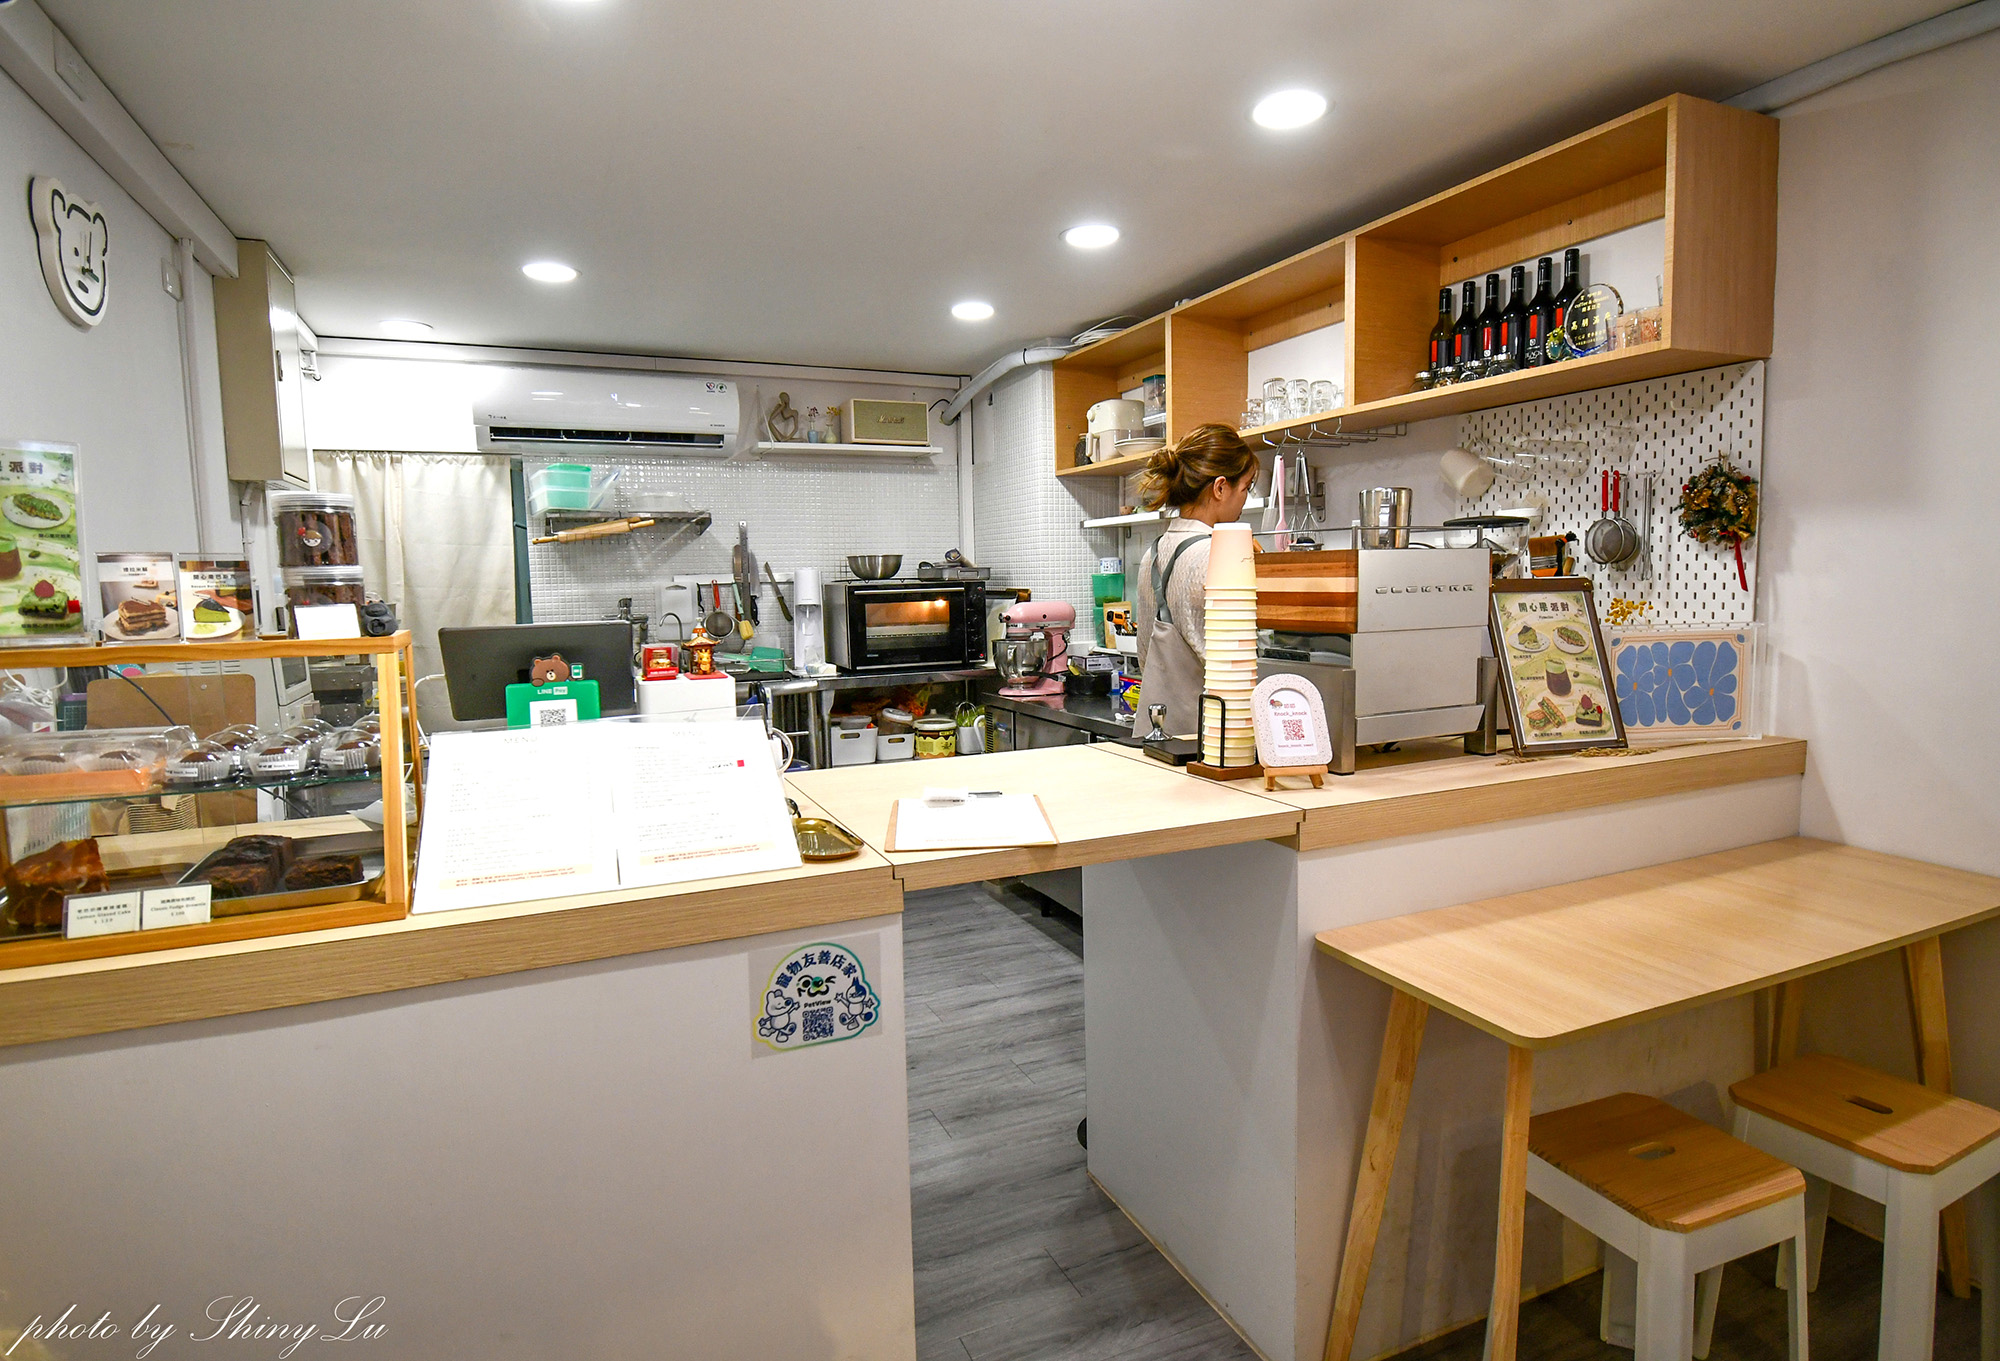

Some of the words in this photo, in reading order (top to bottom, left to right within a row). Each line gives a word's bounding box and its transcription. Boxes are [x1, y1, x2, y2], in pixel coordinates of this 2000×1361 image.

[0, 461, 43, 475] 派對
[1375, 584, 1474, 595] ELEKTRA
[1518, 602, 1570, 612] 開心果派對
[504, 736, 538, 744] MENU
[776, 950, 858, 989] 寵物友善店家
[803, 999, 832, 1008] PetView
